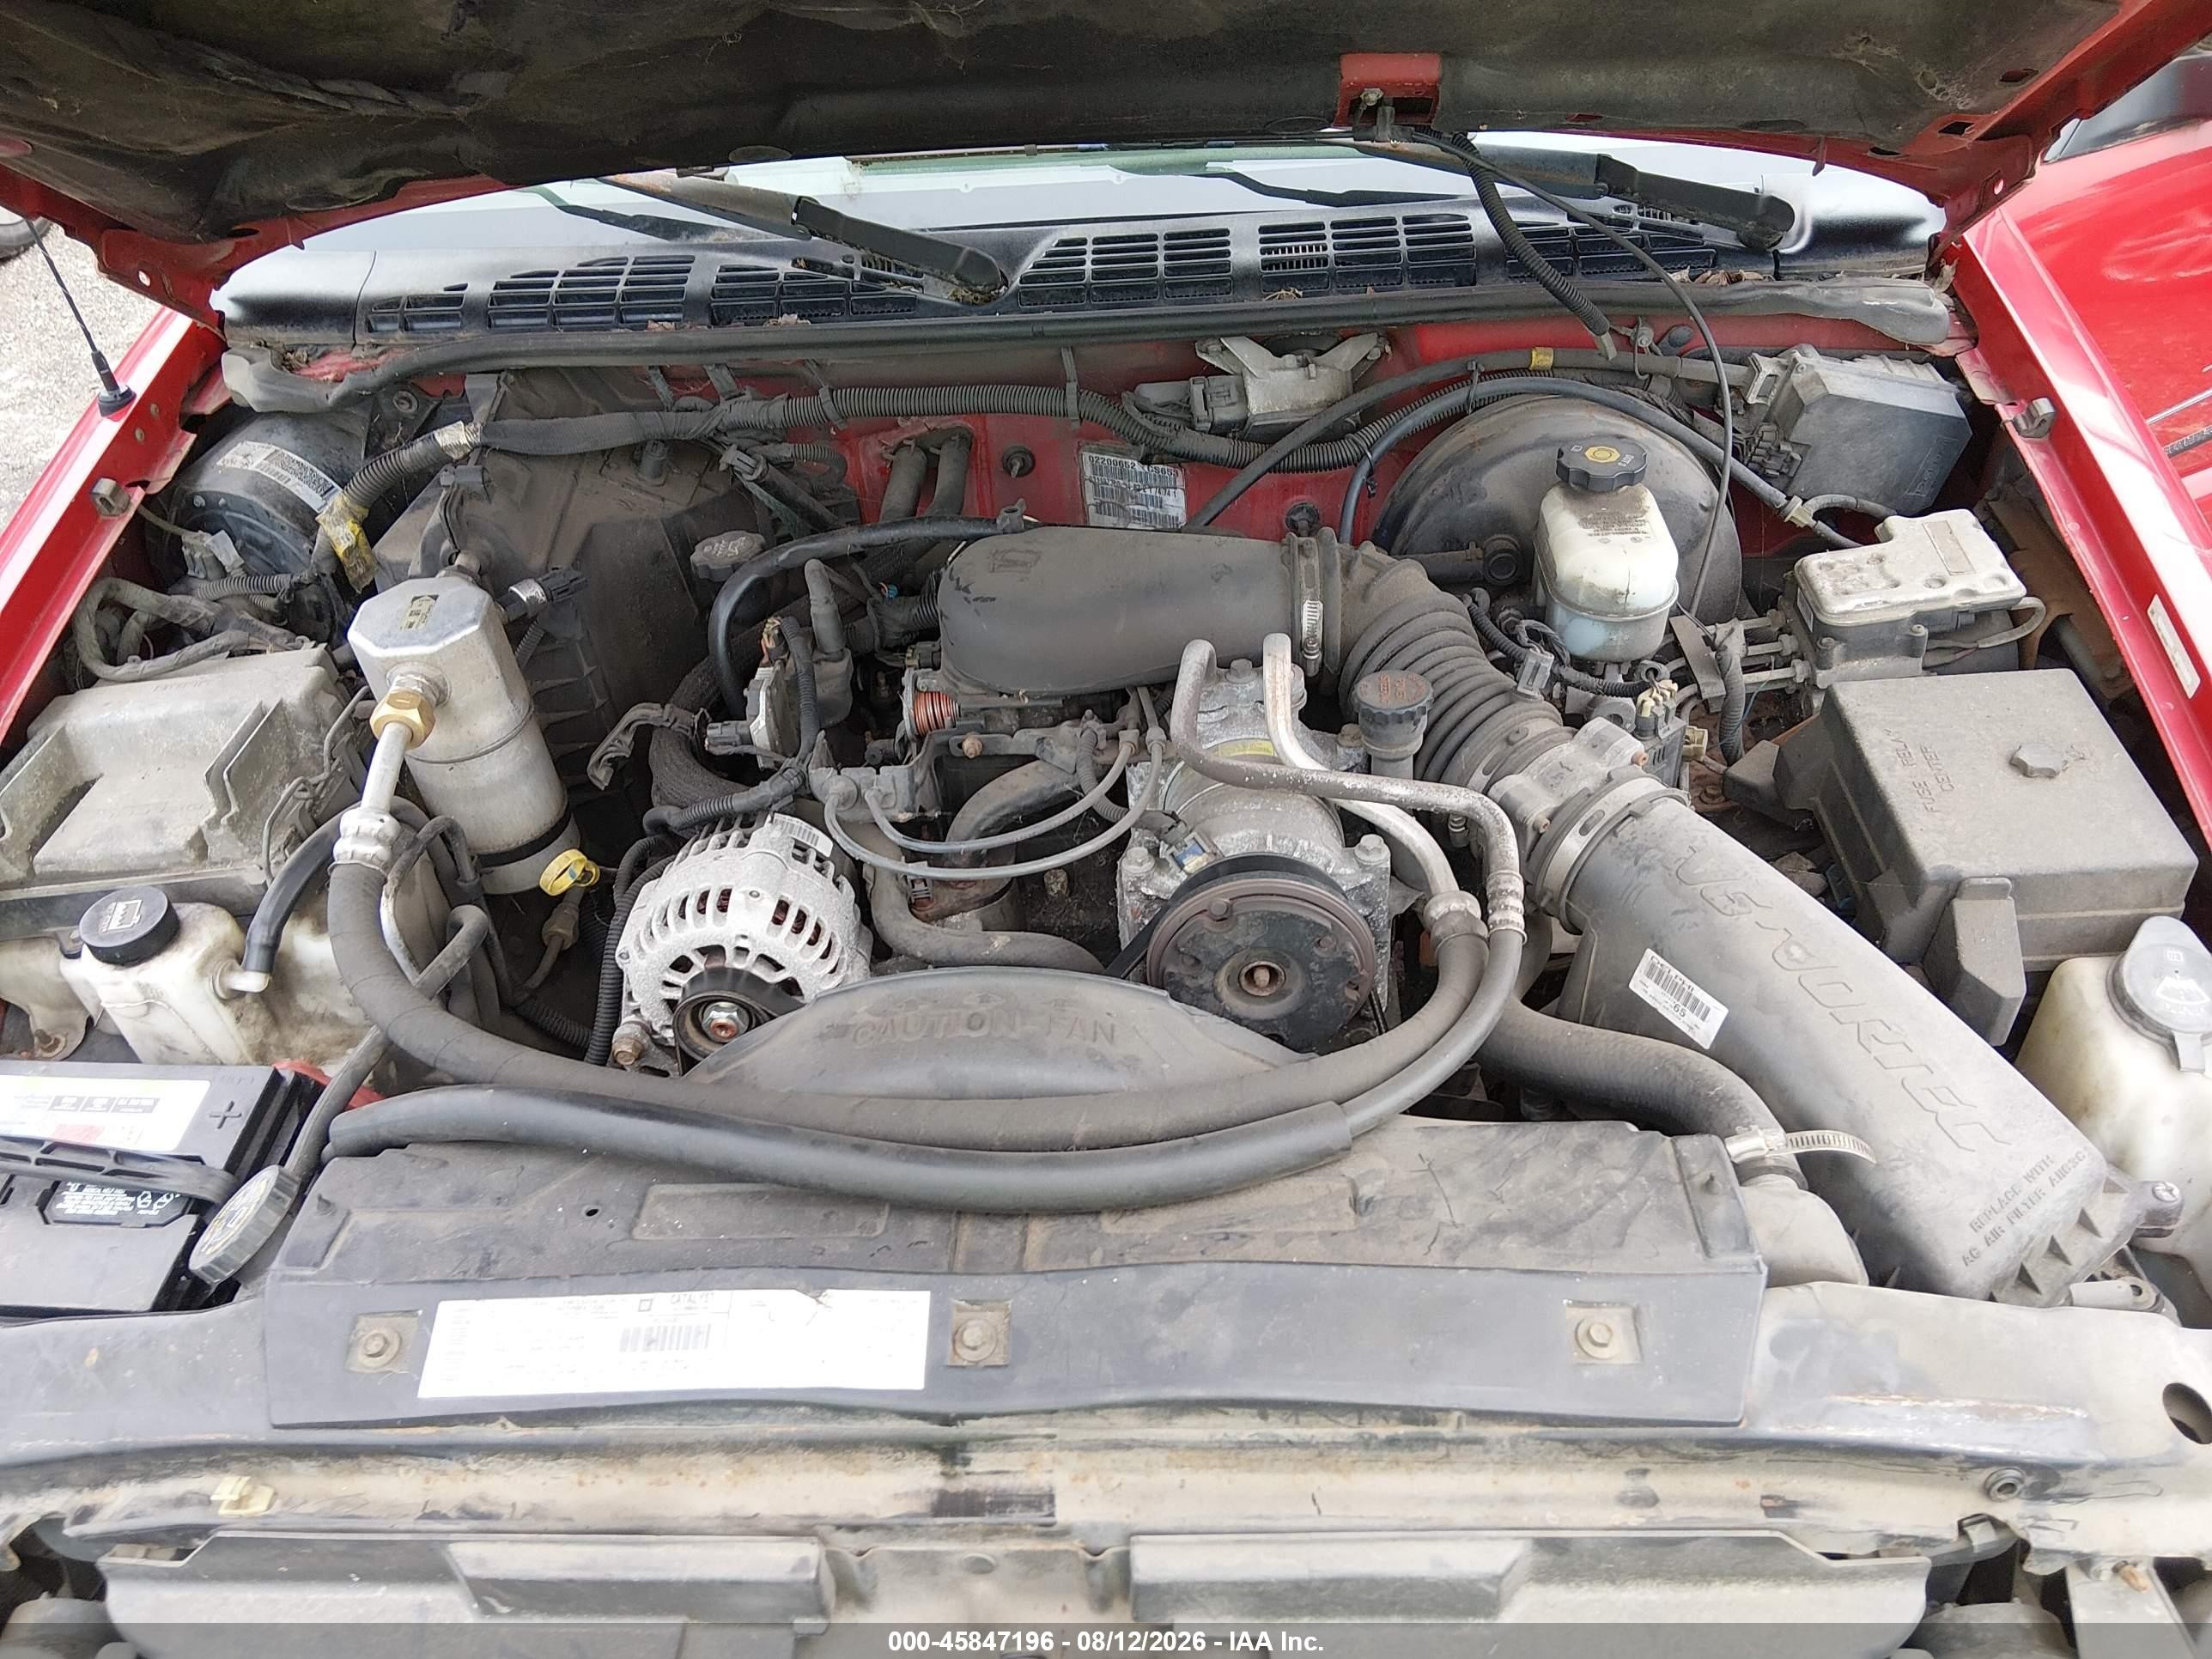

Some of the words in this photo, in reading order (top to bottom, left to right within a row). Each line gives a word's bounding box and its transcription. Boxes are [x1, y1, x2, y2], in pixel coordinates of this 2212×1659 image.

[1920, 744, 1955, 792] CENTER
[1912, 781, 1941, 812] FUSE
[1650, 955, 1695, 993] DELPHI
[852, 1010, 1020, 1047] CAUTION
[1047, 1016, 1115, 1044] FAN
[1673, 1003, 1686, 1018] 65
[1969, 1182, 2021, 1233] REPLACE
[2022, 1154, 2055, 1184] WITH
[1984, 1225, 2006, 1247] AIR
[2006, 1188, 2046, 1225] FILTER
